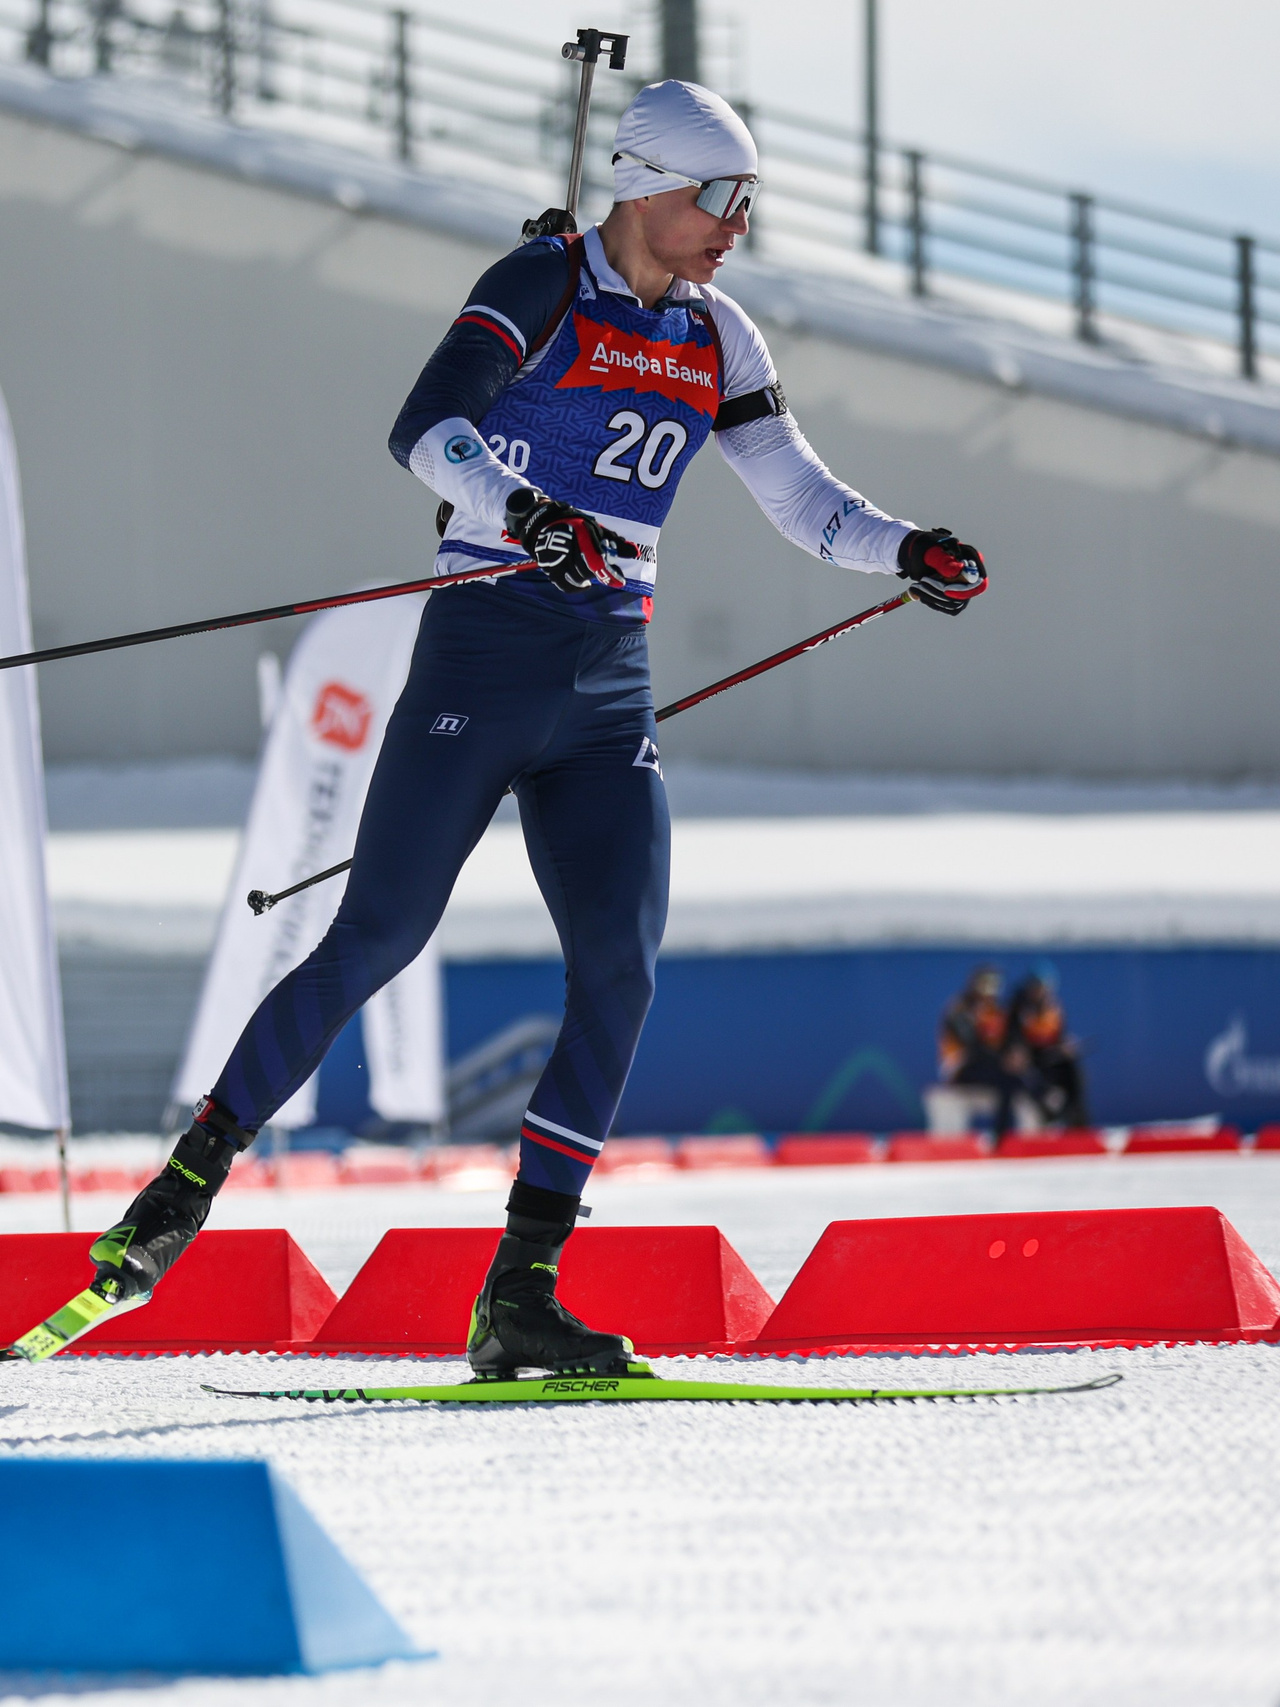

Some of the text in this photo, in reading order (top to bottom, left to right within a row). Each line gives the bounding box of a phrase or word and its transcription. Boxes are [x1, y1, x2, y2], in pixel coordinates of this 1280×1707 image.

[590, 342, 714, 389] Альфа Банк
[488, 434, 531, 474] 20
[593, 410, 687, 489] 20
[542, 1381, 619, 1393] FISCHER
